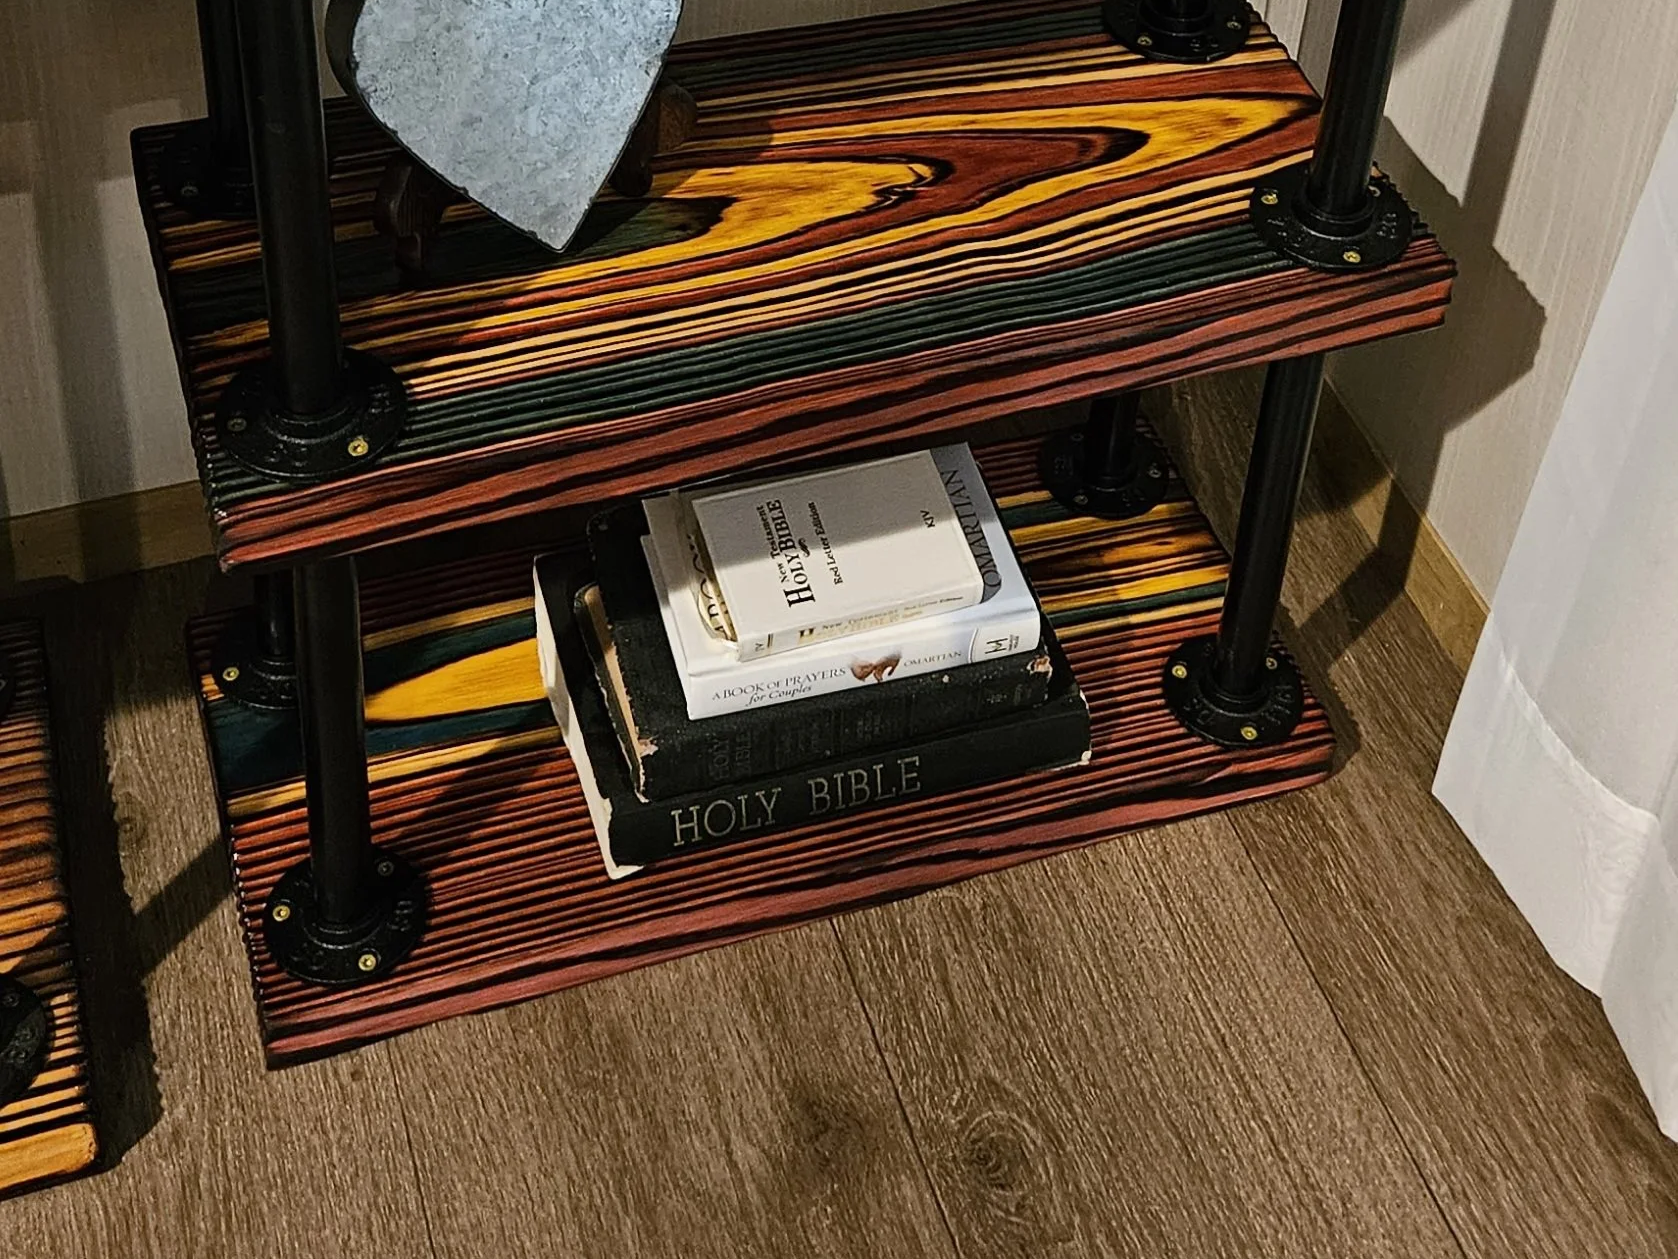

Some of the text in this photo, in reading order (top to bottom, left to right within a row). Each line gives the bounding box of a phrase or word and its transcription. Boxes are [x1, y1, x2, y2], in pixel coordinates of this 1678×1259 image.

[756, 505, 790, 584] New Testament
[766, 499, 797, 553] BIBLE
[808, 502, 844, 585] Red Letter Edition
[919, 509, 936, 529] KJV
[783, 551, 816, 608] HOLY
[723, 683, 766, 701] BOOK
[780, 667, 847, 688] PRAYERS
[904, 650, 963, 667] OMARTIAN
[745, 685, 813, 708] for Couples
[670, 755, 921, 847] HOLY BIBLE
